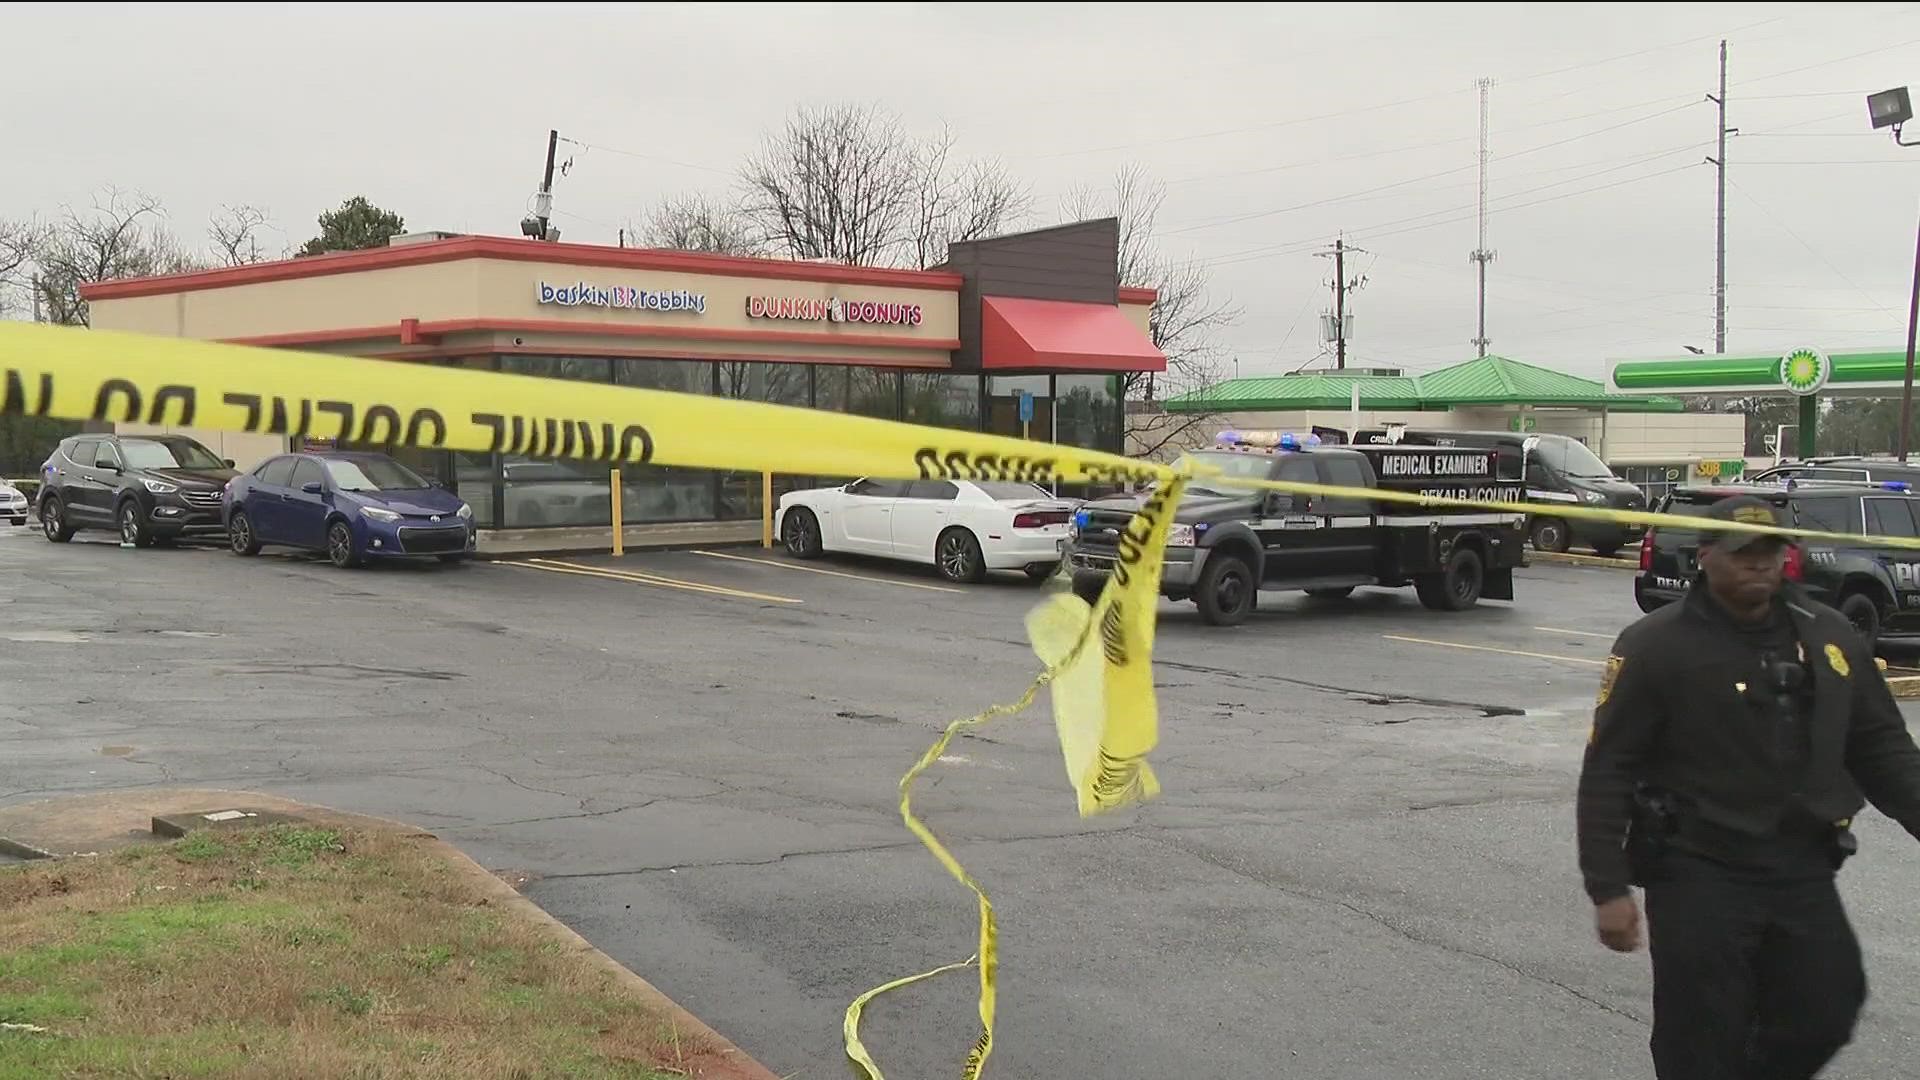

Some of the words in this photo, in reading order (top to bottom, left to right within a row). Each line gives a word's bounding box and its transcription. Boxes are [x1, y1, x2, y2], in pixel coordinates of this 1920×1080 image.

[540, 281, 610, 306] baskin
[639, 291, 706, 313] robbins
[848, 301, 922, 326] DONUTS
[1382, 455, 1432, 475] MEDICAL
[1434, 455, 1489, 475] EXAMINER
[1477, 486, 1522, 503] COUNTY
